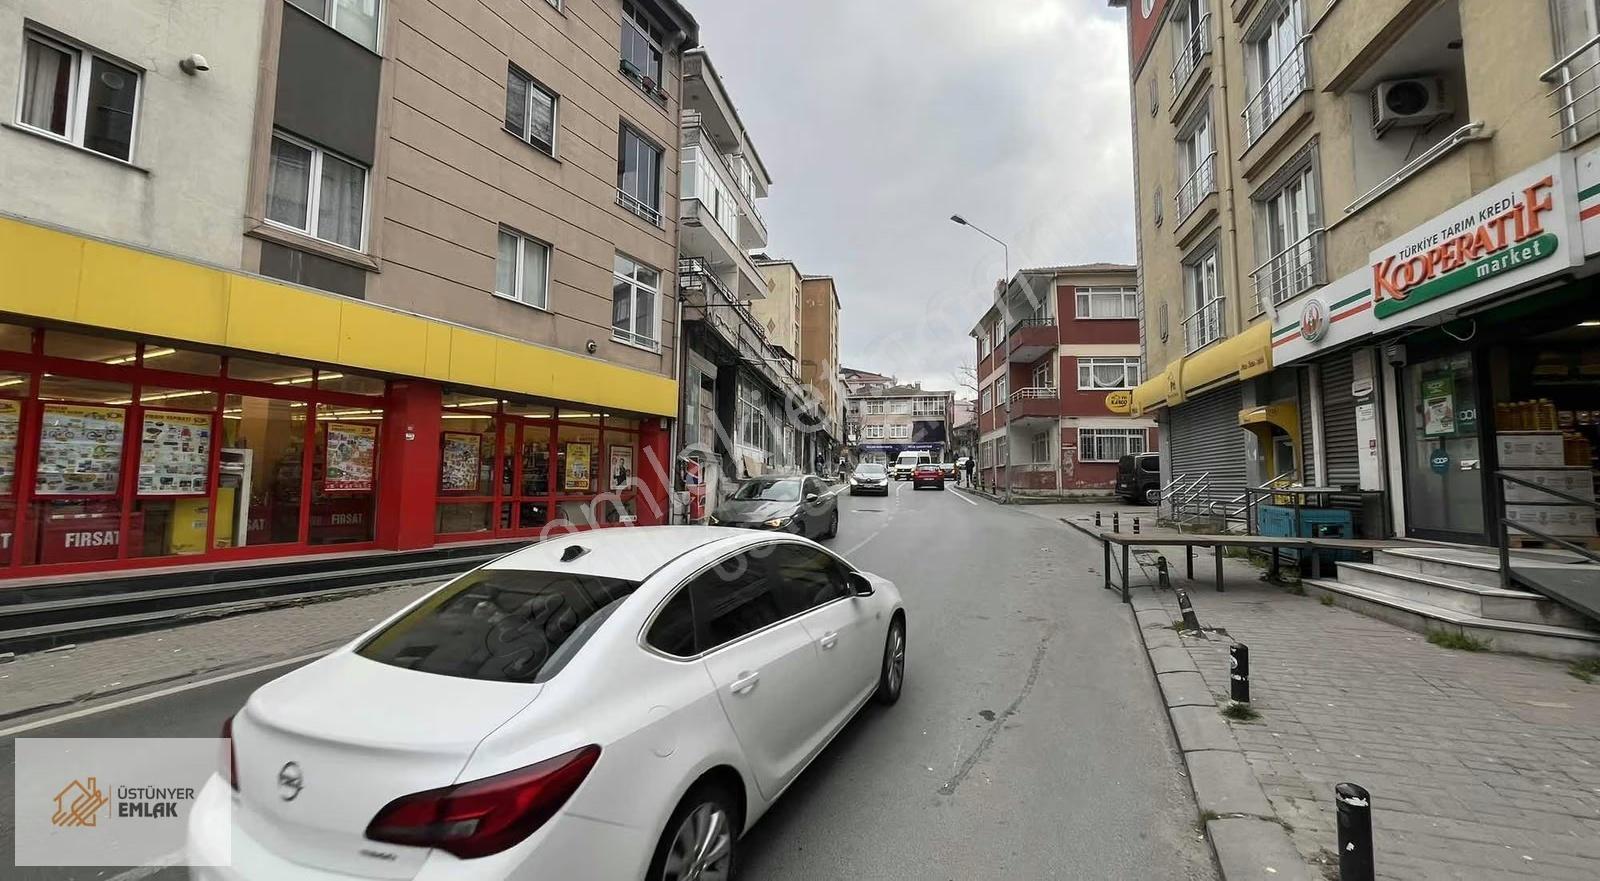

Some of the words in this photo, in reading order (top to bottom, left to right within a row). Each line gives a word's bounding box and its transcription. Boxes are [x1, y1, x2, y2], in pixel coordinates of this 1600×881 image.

[1399, 234, 1438, 261] TÜRKİYE
[1442, 215, 1475, 239] TARIM
[1479, 192, 1516, 221] KREDİ
[1476, 241, 1541, 278] market
[65, 531, 119, 548] FIRSAT
